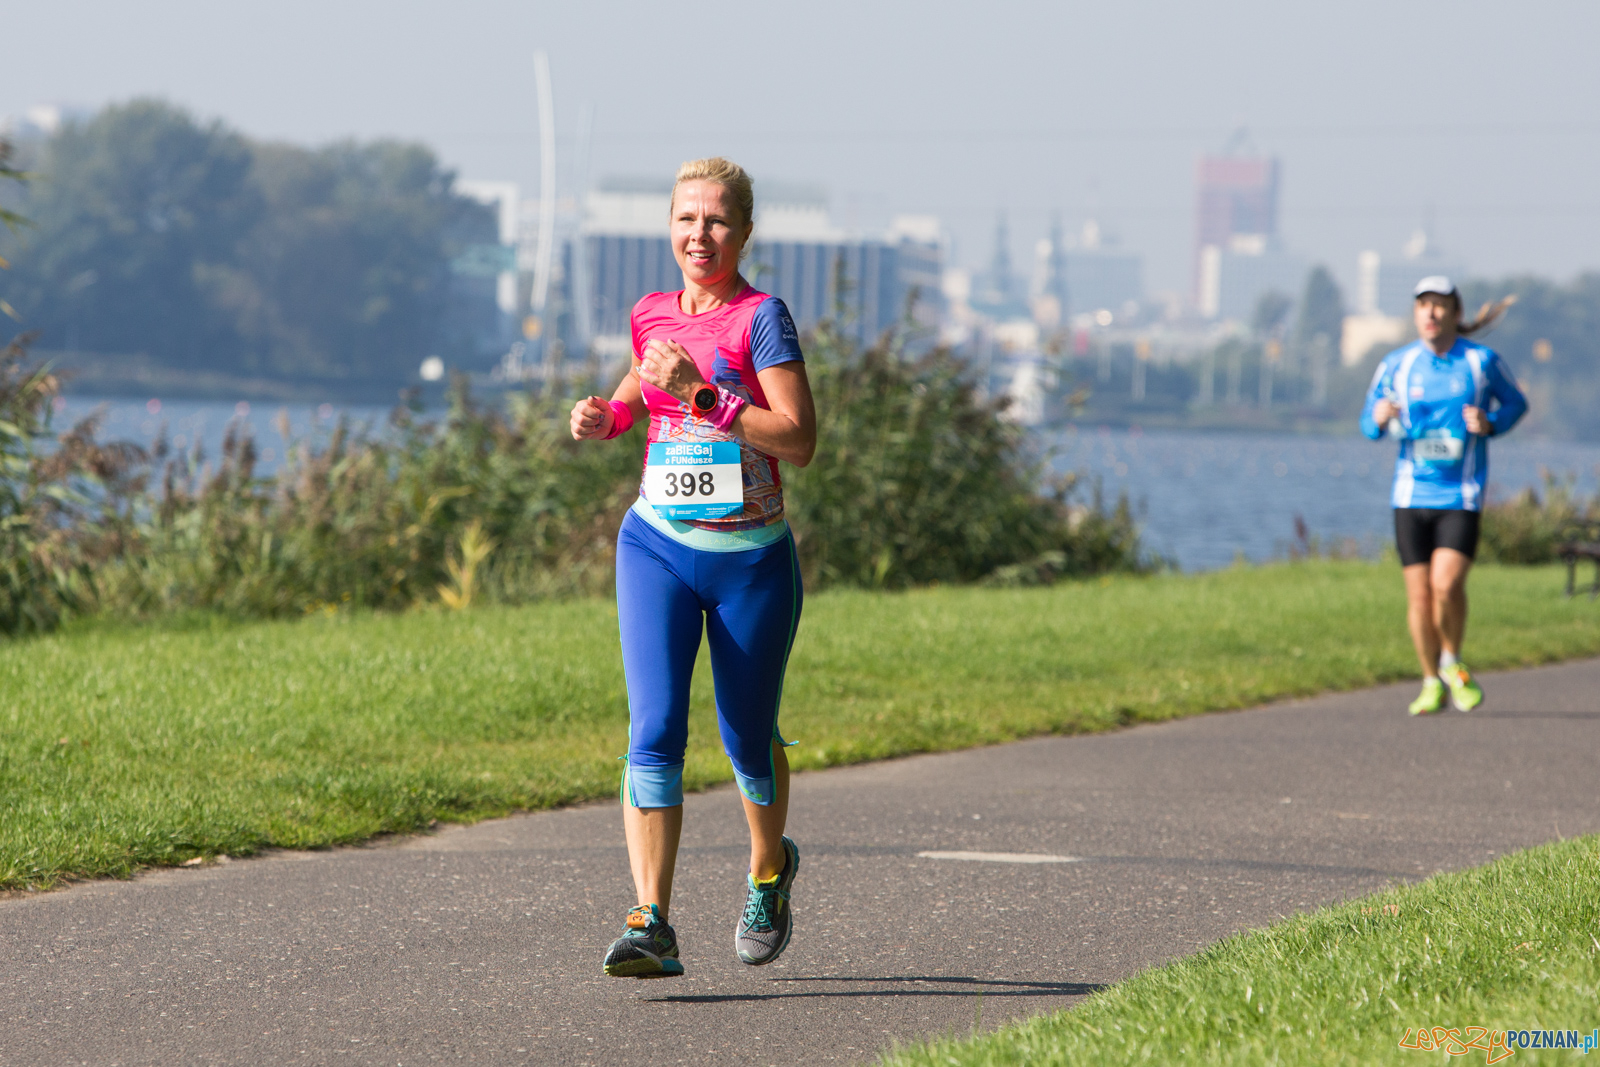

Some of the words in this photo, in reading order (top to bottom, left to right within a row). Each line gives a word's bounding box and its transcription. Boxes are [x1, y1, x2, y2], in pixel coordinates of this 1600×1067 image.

[665, 444, 713, 457] zaBIEGaj
[671, 456, 714, 465] FUNdusze
[664, 471, 715, 497] 398
